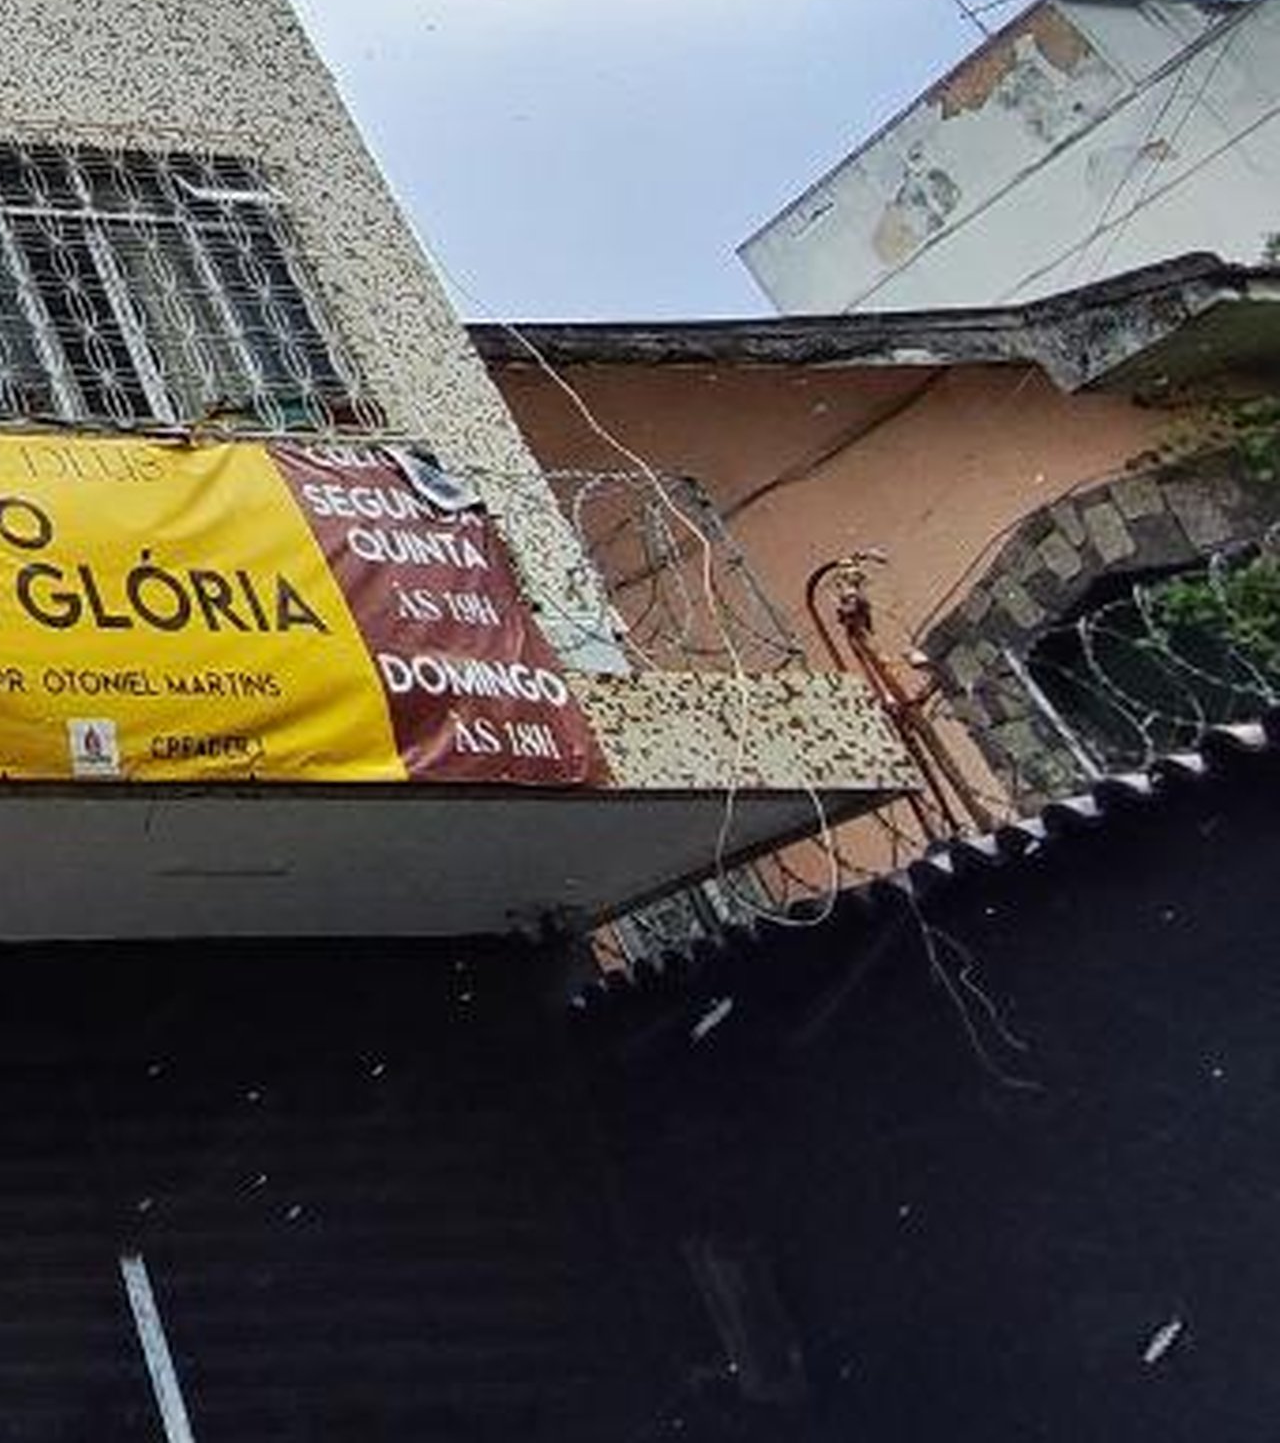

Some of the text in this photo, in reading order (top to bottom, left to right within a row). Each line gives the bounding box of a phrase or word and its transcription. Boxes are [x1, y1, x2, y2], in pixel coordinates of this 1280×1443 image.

[345, 527, 490, 571] QUINTA
[15, 548, 329, 634] GLÓRIA
[42, 669, 159, 697] OTONIEL
[166, 671, 282, 697] MARTINS
[377, 653, 570, 707] DOMINGO
[449, 709, 502, 754] ÀS
